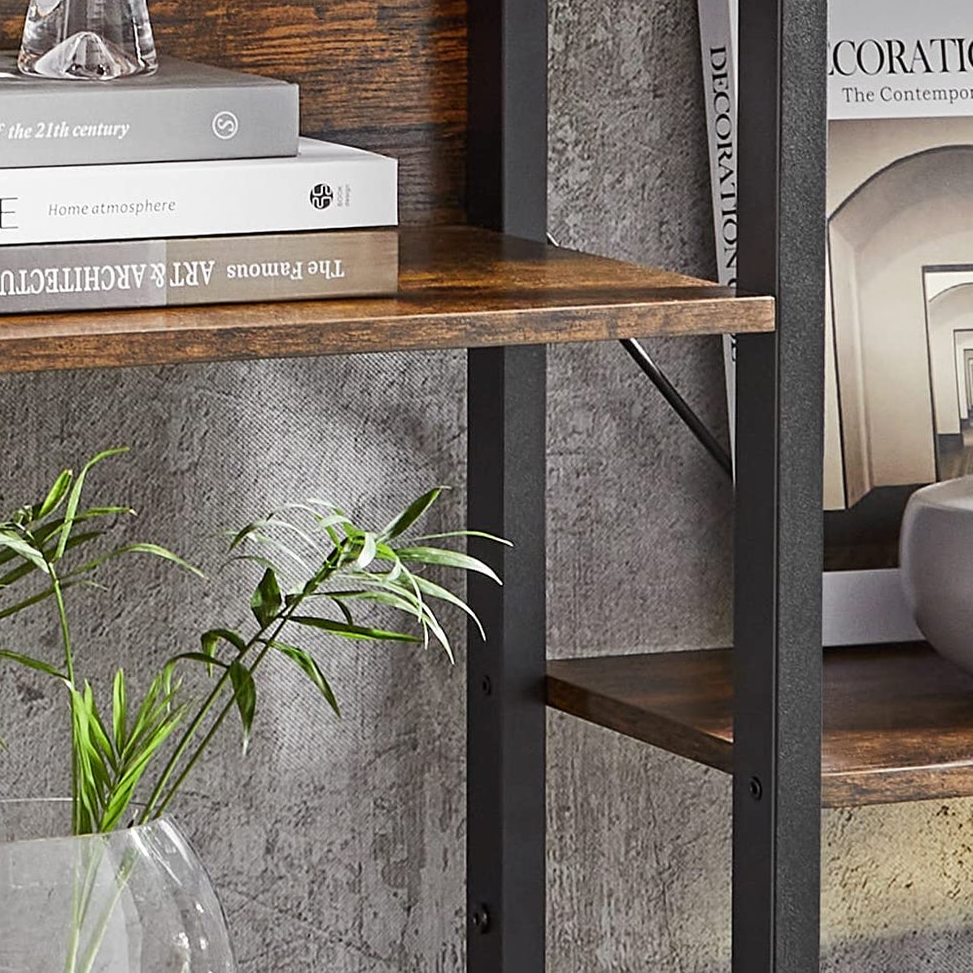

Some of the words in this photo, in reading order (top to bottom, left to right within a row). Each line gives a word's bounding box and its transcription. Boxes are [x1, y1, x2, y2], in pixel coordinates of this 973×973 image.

[828, 38, 973, 76] CORATI
[842, 87, 875, 103] The
[8, 122, 33, 140] the
[34, 121, 70, 139] 21th
[72, 122, 130, 140] century
[710, 46, 737, 268] DECORATION
[48, 201, 89, 217] Home
[91, 199, 176, 217] atmosphere
[150, 262, 166, 288] &
[169, 260, 216, 287] ART
[226, 261, 304, 280] Famous
[307, 259, 345, 280] The
